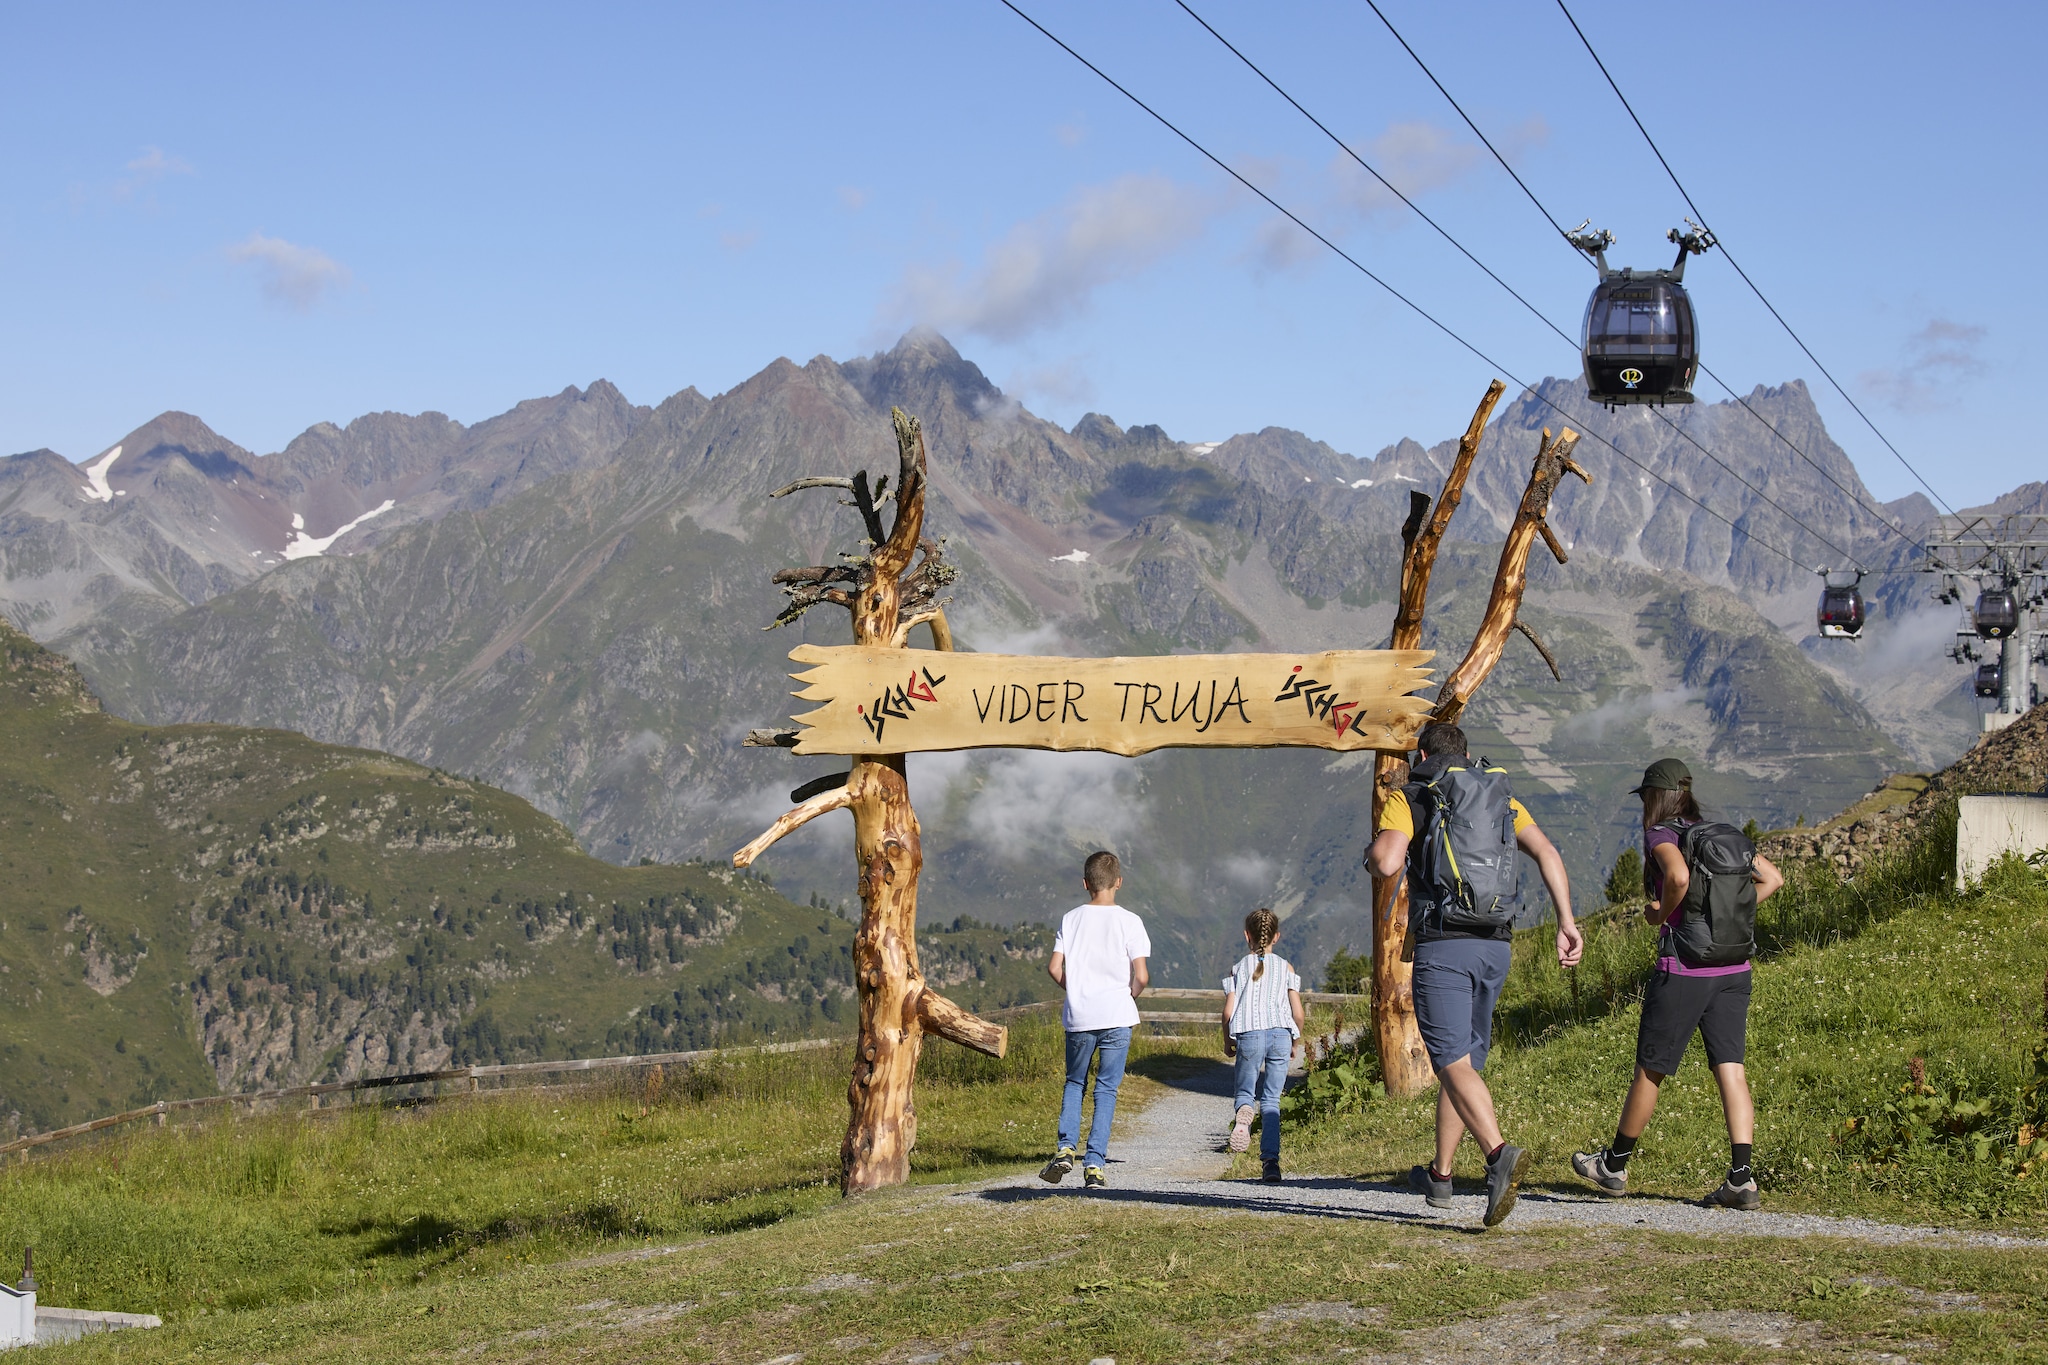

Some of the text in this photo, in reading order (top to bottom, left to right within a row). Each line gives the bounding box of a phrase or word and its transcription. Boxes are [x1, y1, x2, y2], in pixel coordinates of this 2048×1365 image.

[1626, 371, 1638, 381] 12
[972, 676, 1252, 732] VIDER TRUJA
